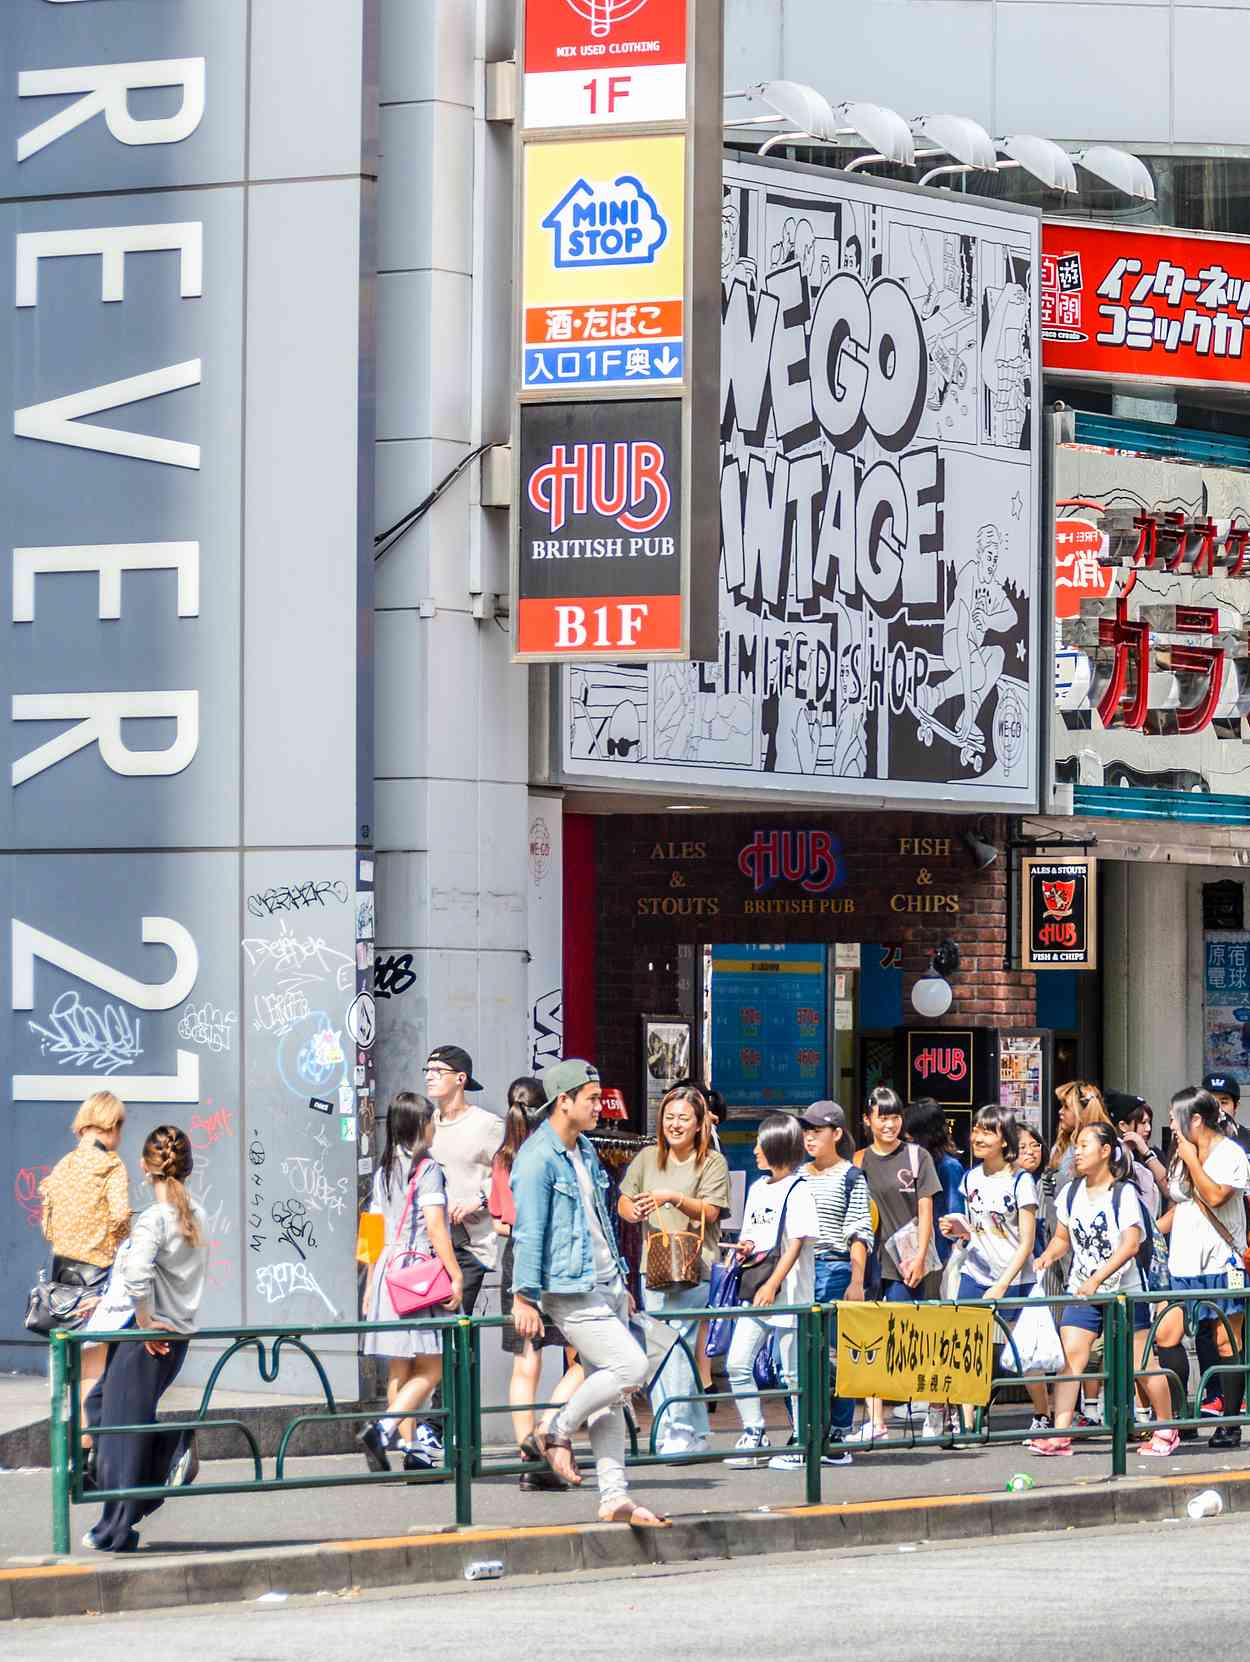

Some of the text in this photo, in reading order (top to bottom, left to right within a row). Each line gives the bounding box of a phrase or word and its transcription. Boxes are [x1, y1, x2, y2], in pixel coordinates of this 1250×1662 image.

[557, 41, 661, 57] MIX USED CLOTHING
[583, 76, 632, 114] 1F
[573, 199, 639, 228] MINI
[568, 227, 643, 257] STOP
[528, 347, 651, 382] 入口1F奥
[12, 0, 206, 787] REVER
[527, 441, 671, 533] HUB
[721, 446, 945, 614] INTAGE
[531, 536, 675, 560] BRITISH PUB
[554, 604, 649, 648] B1F
[699, 630, 929, 713] LIMITED SHOP
[650, 842, 706, 860] ALES
[899, 838, 951, 857] FISH
[738, 830, 837, 893] HUB
[1031, 866, 1051, 875] ALES
[1057, 866, 1087, 875] STOUTS
[669, 870, 686, 888] &
[916, 867, 933, 886] &
[637, 897, 720, 916] STOUTS
[744, 898, 856, 915] BRITISH PUB
[890, 894, 961, 914] CHIPS
[1039, 921, 1078, 947] HUB
[1032, 952, 1051, 961] FISH
[1059, 952, 1084, 961] CHIPS
[1208, 944, 1248, 967] 原宿
[12, 917, 199, 1103] 21
[914, 1046, 968, 1081] HUB
[916, 1374, 952, 1392] 警視庁
